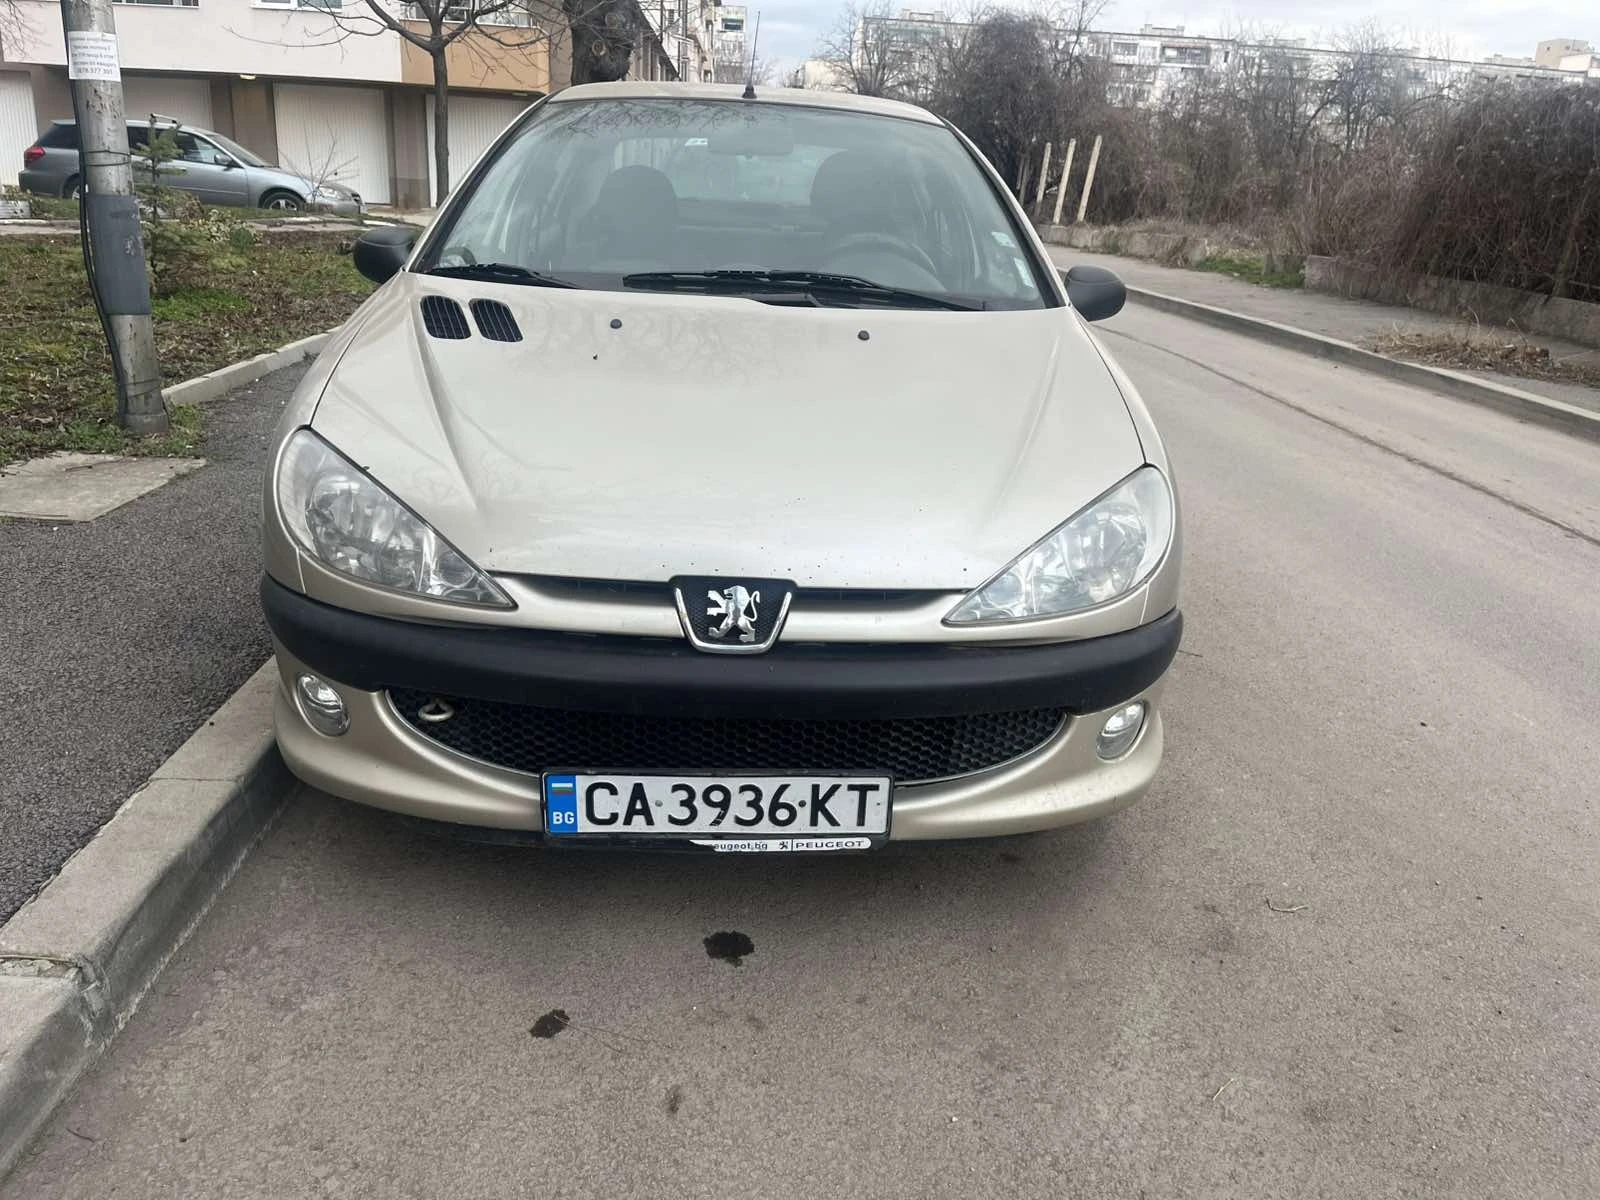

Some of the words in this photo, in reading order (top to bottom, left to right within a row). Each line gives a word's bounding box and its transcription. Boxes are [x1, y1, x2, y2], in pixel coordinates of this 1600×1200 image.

[585, 781, 655, 826] CA
[667, 783, 798, 828] 3936
[809, 783, 880, 828] KT
[552, 811, 575, 825] BG
[713, 842, 768, 850] eugeot.bg
[795, 841, 865, 849] PEUGEOT
